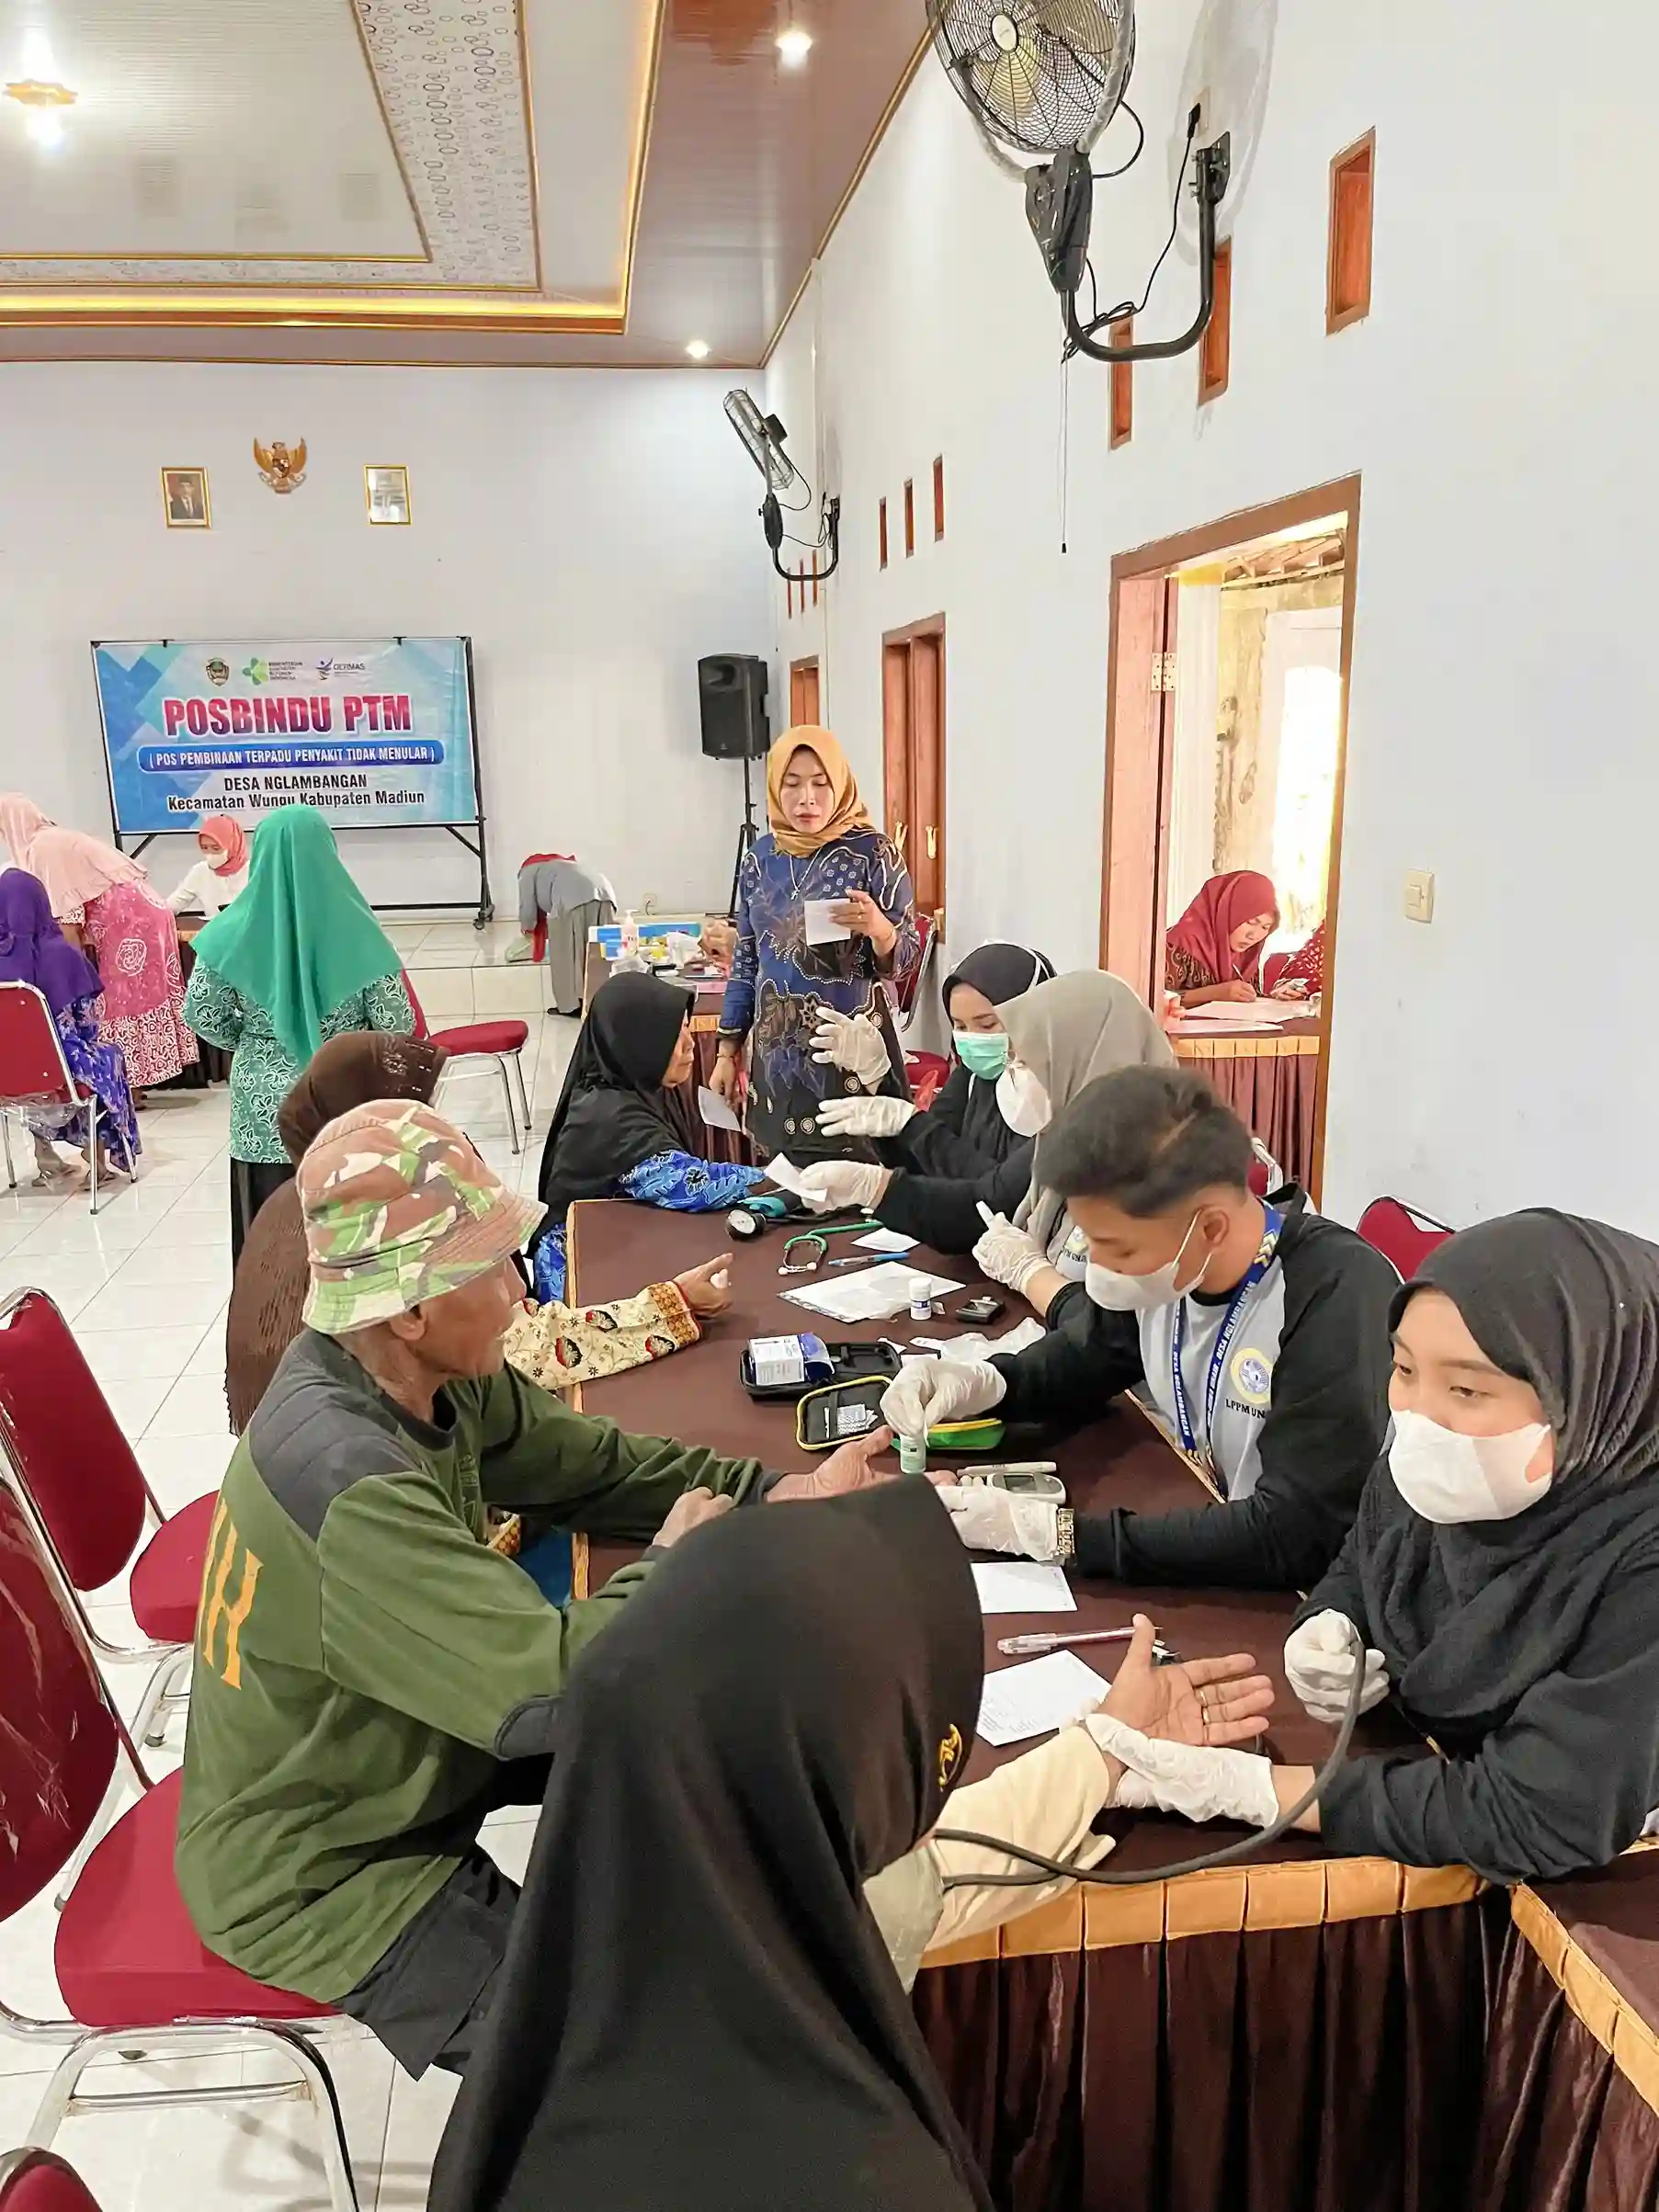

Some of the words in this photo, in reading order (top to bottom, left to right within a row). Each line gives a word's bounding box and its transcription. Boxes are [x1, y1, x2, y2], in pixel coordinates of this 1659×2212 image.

[164, 697, 331, 736] POSBINDU
[343, 694, 412, 732] PTM
[156, 752, 179, 766] POS
[180, 750, 243, 765] PEMBINAAN
[244, 749, 292, 764] TERPADU
[294, 748, 343, 762] PENYAKIT
[346, 748, 376, 761] TIDAK
[378, 747, 428, 761] MENULAR
[224, 777, 260, 791] DESA
[265, 774, 367, 790] NGLAMBANGAN
[167, 795, 244, 811] Kecamatan
[300, 791, 371, 808] Kabupaten
[375, 789, 425, 804] Madiun
[1215, 1339, 1228, 1361] DESA
[1225, 1399, 1251, 1415] LPPM
